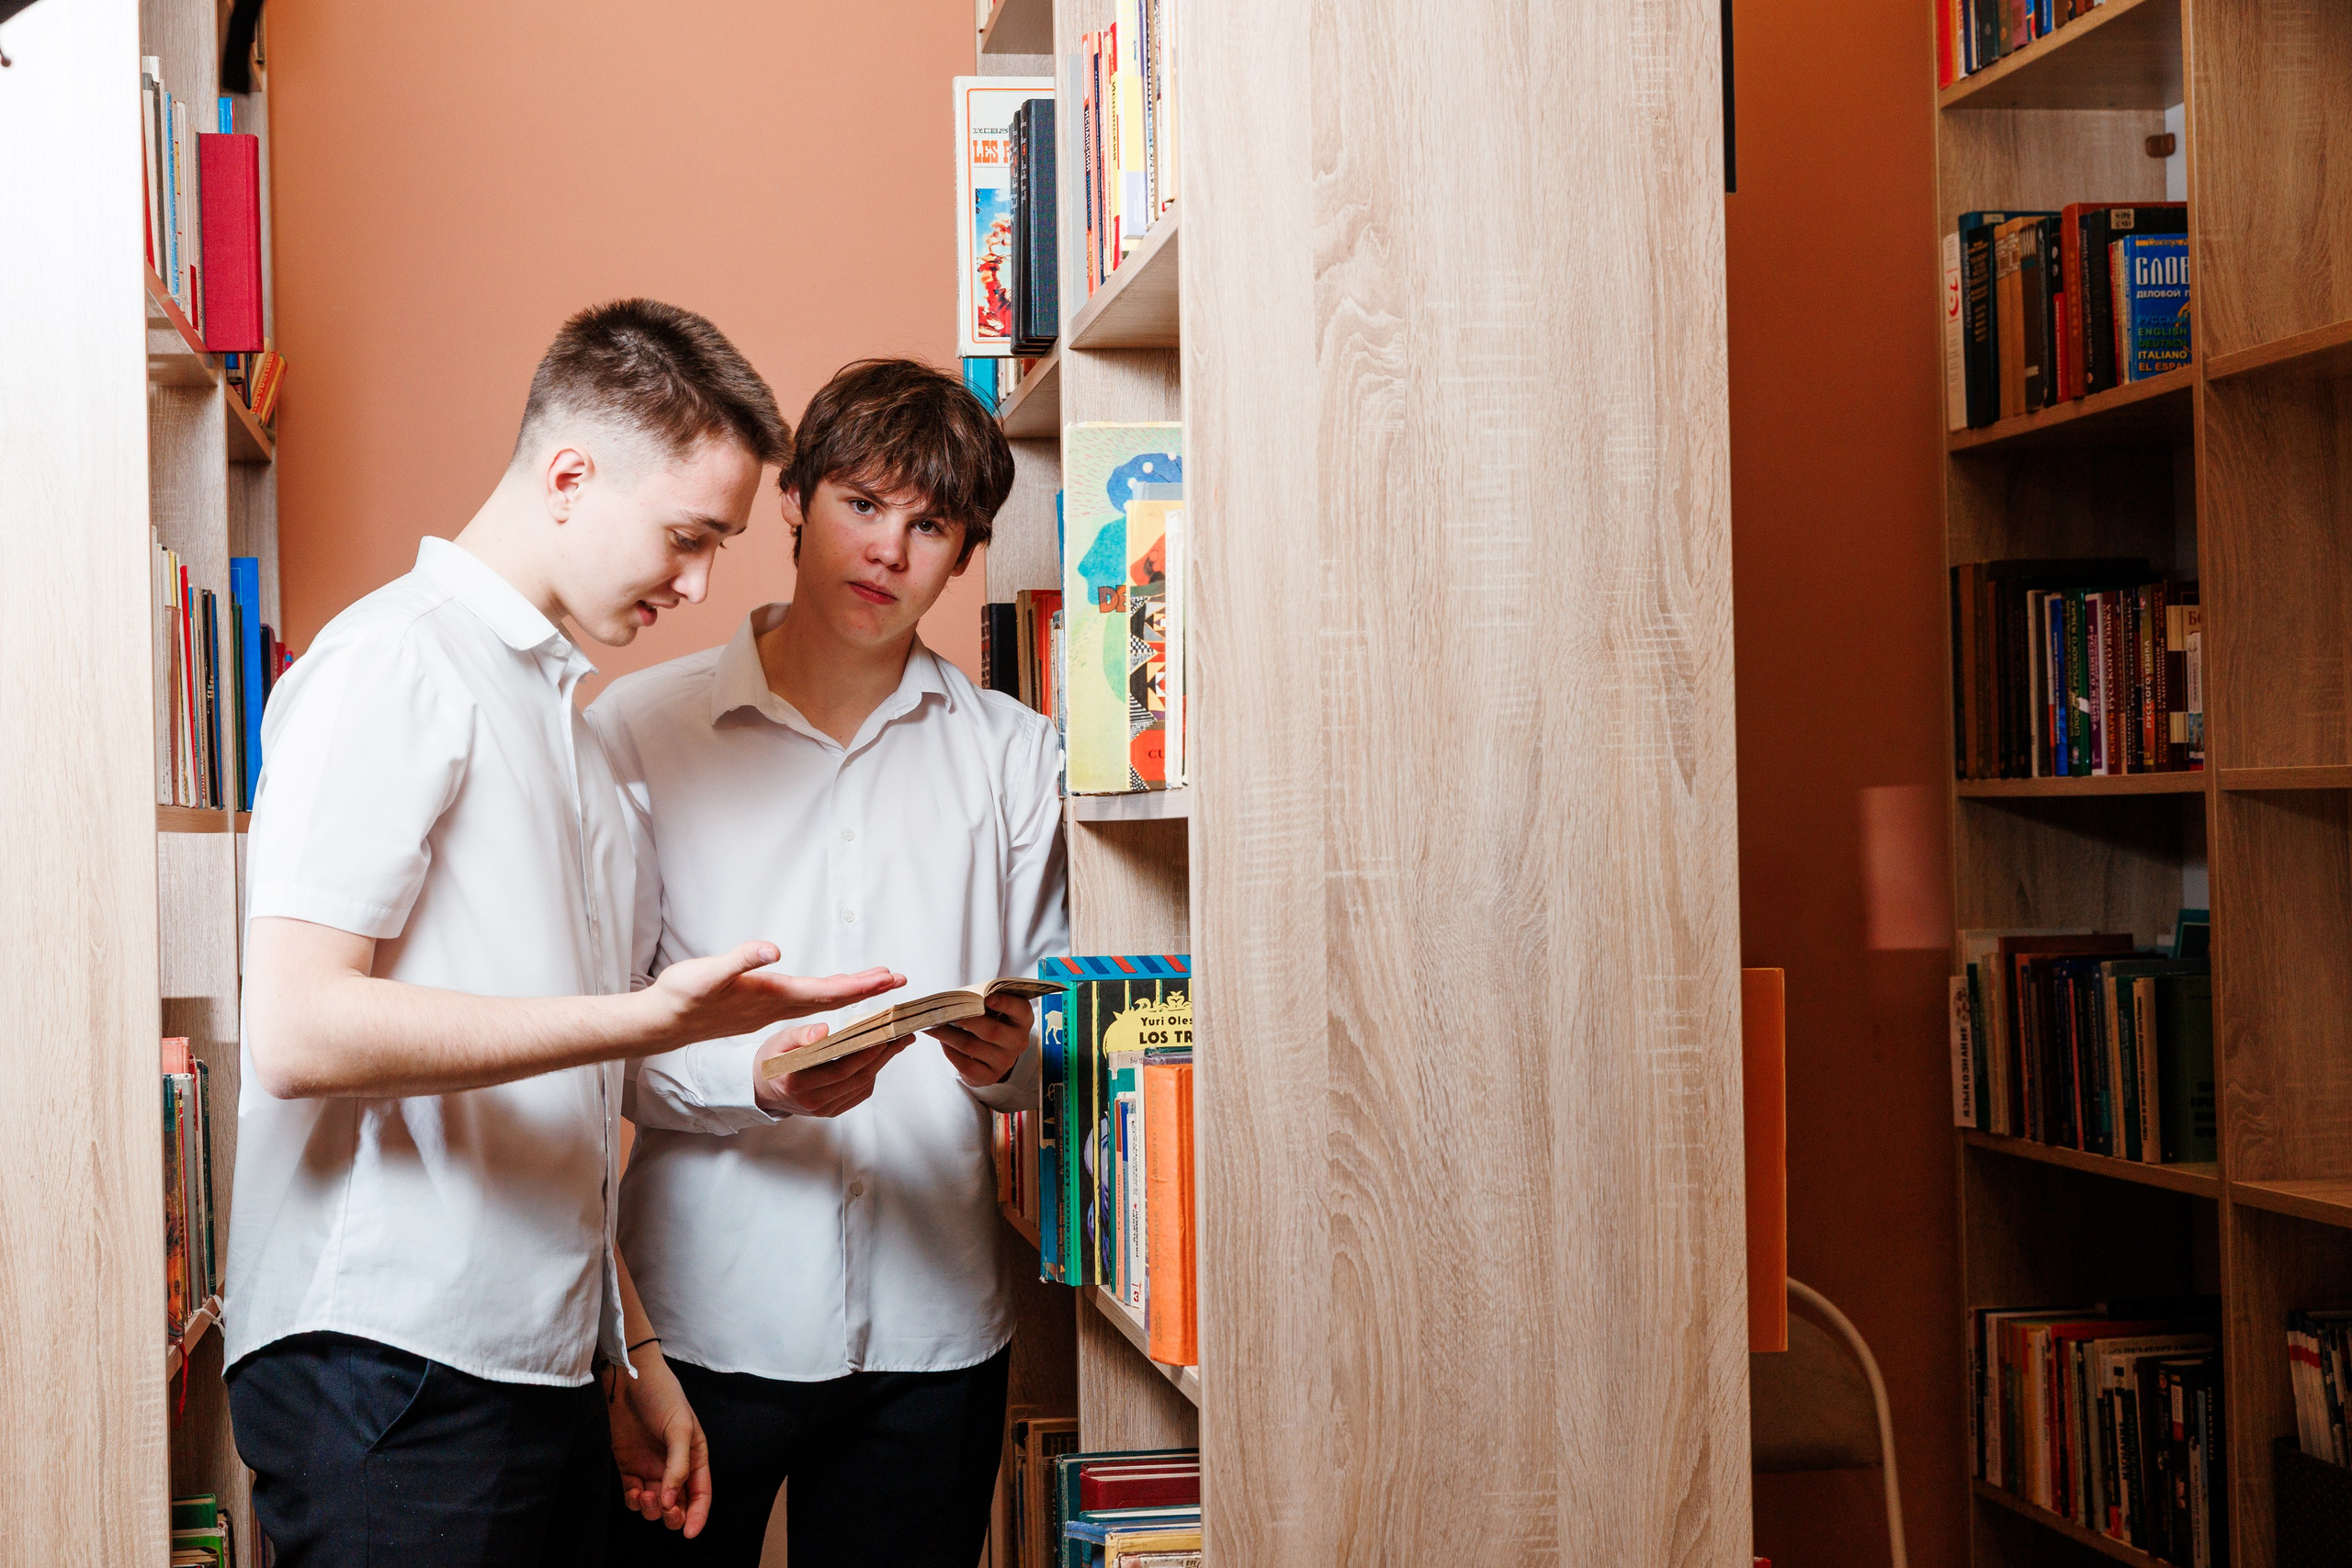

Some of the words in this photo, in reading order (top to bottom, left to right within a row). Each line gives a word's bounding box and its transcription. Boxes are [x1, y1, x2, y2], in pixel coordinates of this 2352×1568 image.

[972, 140, 999, 164] LES
[2136, 288, 2181, 299] ДЕЛОВОЙ
[2137, 315, 2188, 325] РУССКИЙ
[2138, 327, 2188, 336] ENGLISH
[2138, 339, 2188, 348] DEUTSCH
[2138, 350, 2188, 359] ITALIANO
[2139, 363, 2153, 371] EL
[2071, 636, 2079, 688] РУССКОГО
[2107, 648, 2116, 710] РУССКОГО
[1148, 749, 1165, 760] CU
[1140, 1016, 1164, 1026] Yuri
[1139, 1031, 1169, 1044] LOS
[1174, 1030, 1193, 1043] TR
[1960, 1027, 1970, 1117] ЯЗЫКОЗНАНИЕ
